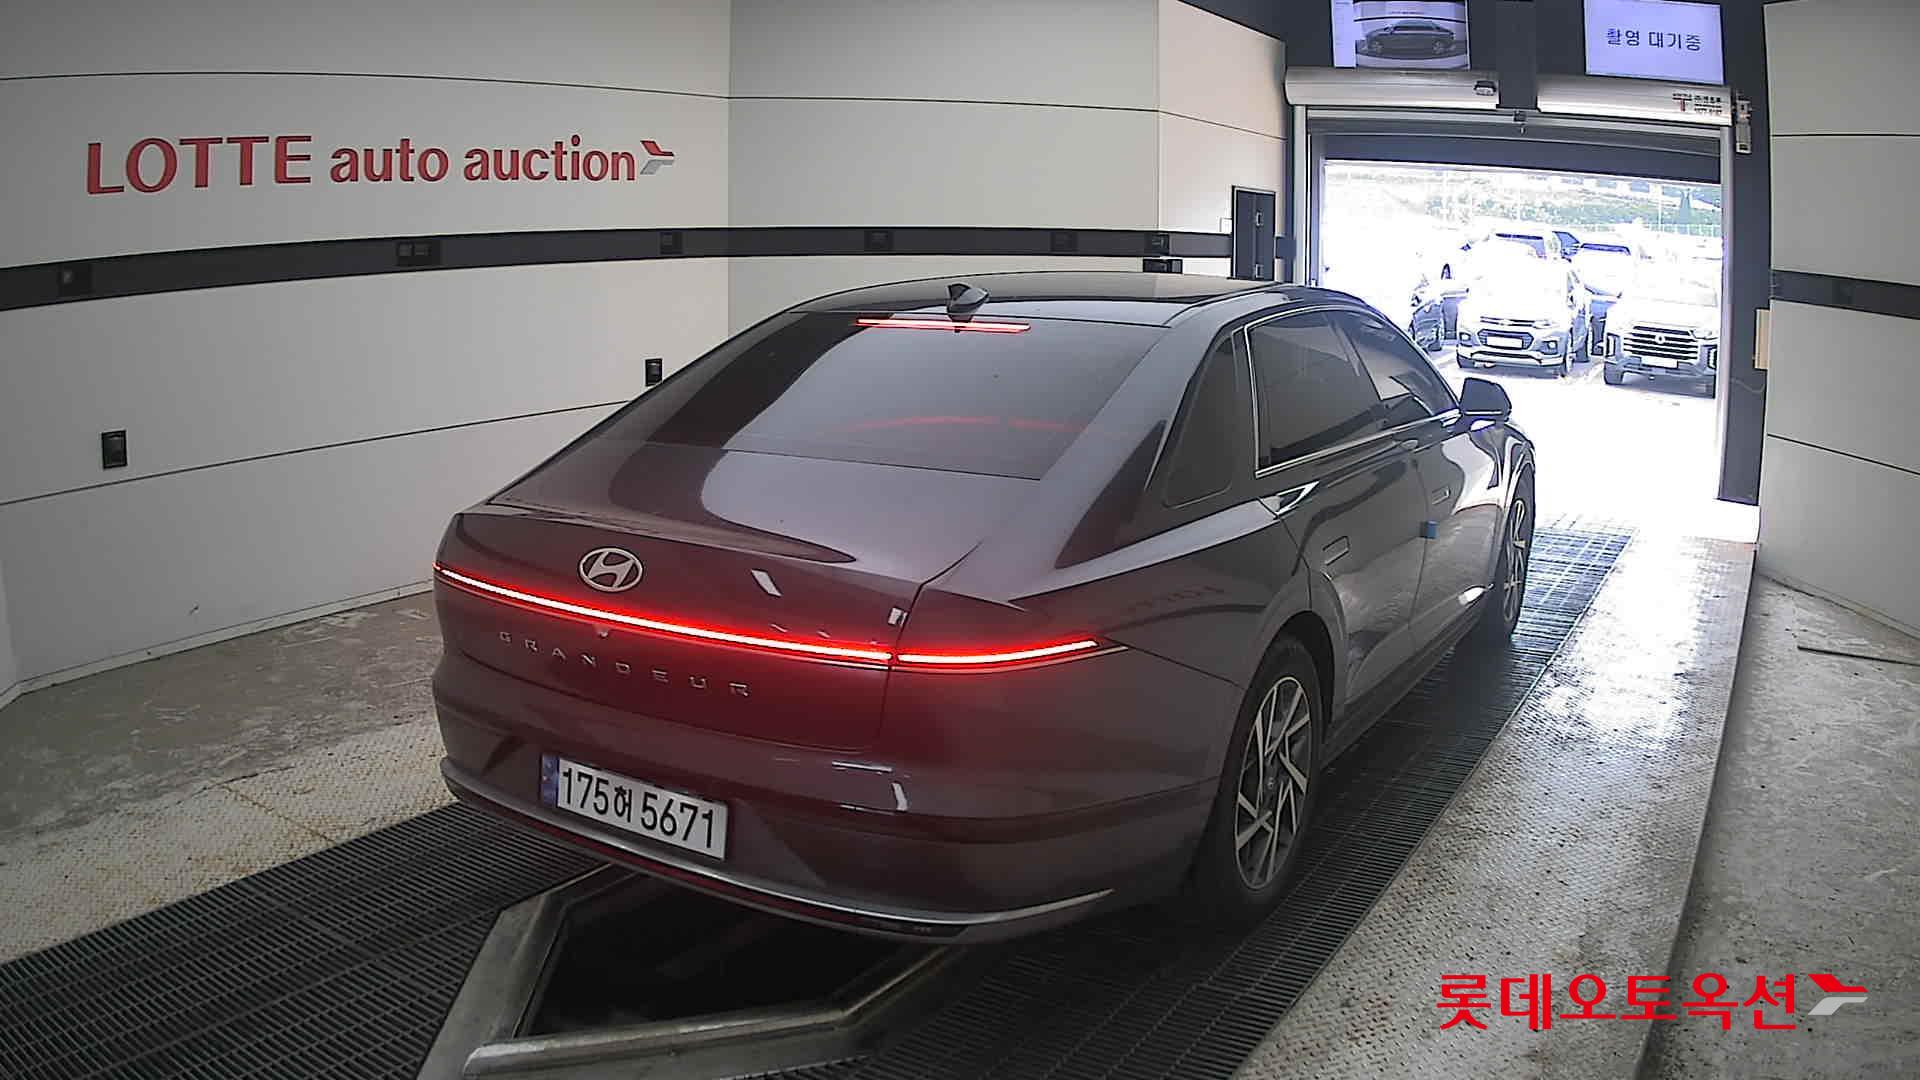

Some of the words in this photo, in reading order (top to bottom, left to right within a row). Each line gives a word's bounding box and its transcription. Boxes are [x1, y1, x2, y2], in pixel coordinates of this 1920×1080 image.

[1607, 27, 1641, 47] 촬영
[1648, 31, 1702, 51] 대기중
[87, 135, 312, 194] LOTTE
[330, 138, 449, 182] auto
[463, 134, 635, 181] auction
[499, 631, 752, 696] GRANDEUR
